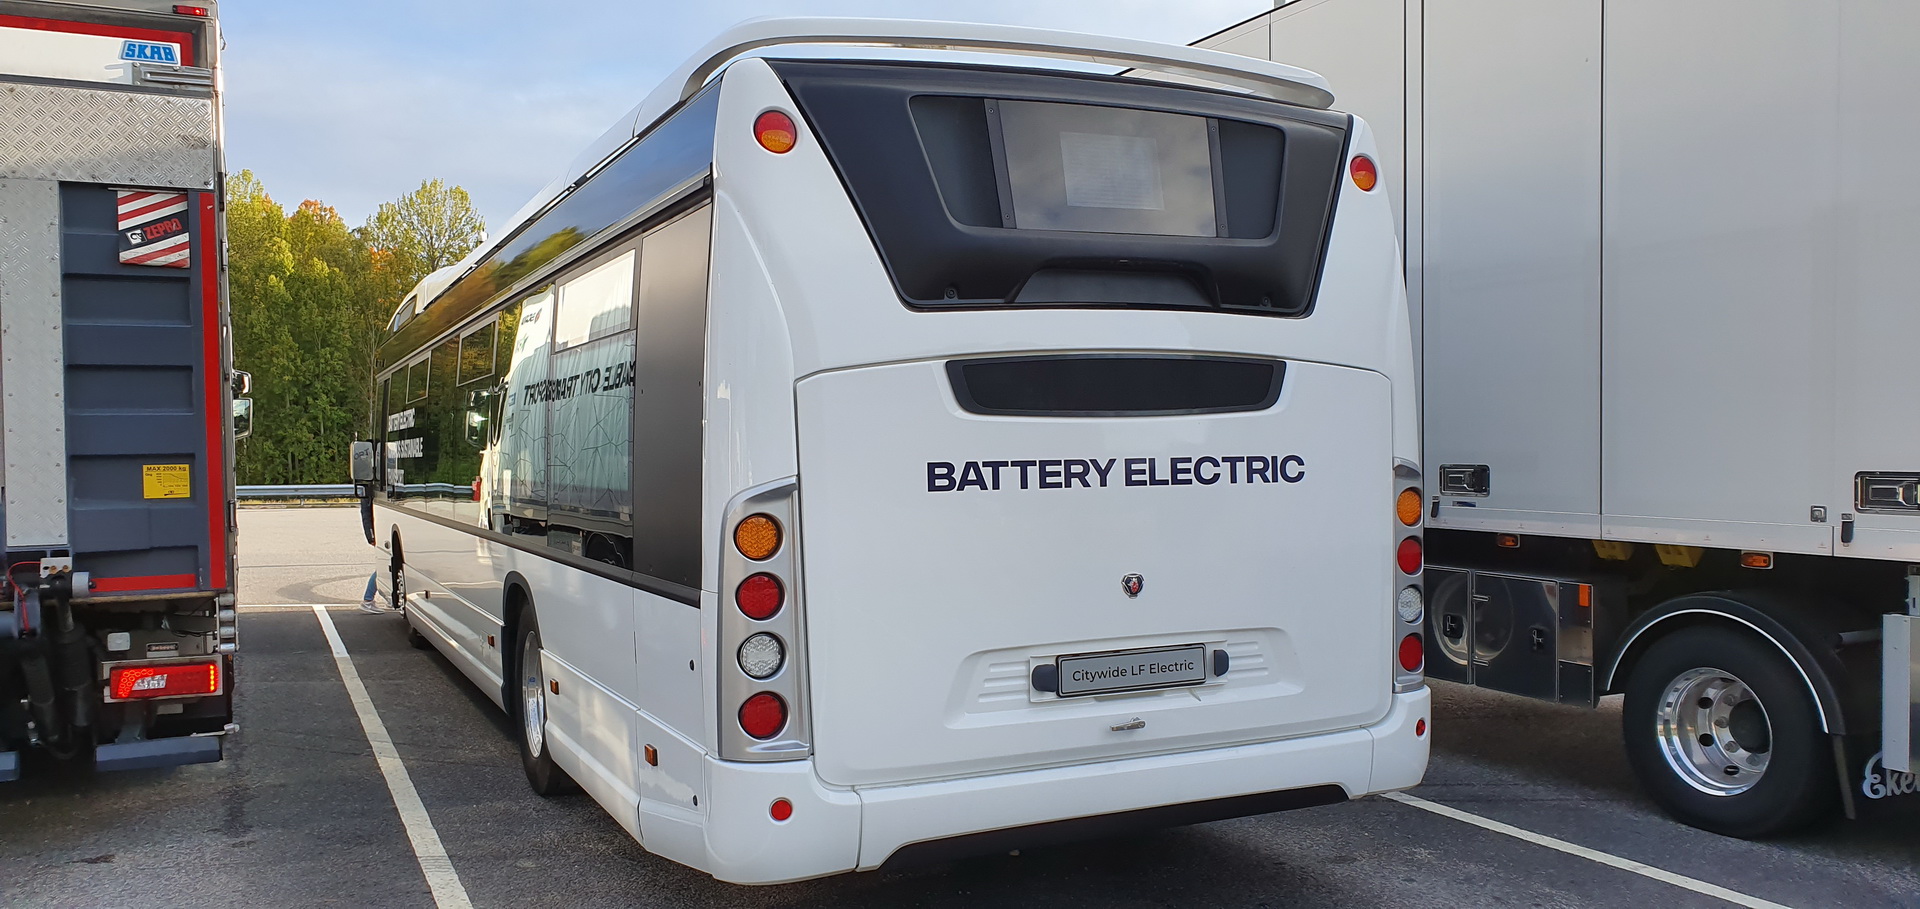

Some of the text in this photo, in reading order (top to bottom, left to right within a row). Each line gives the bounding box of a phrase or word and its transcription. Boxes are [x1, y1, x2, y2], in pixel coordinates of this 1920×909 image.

[125, 43, 175, 62] SKAB
[143, 218, 182, 240] ZEPRO
[926, 454, 1306, 493] BATTERY ELECTRIC
[1072, 659, 1194, 683] Citywide LF Electric
